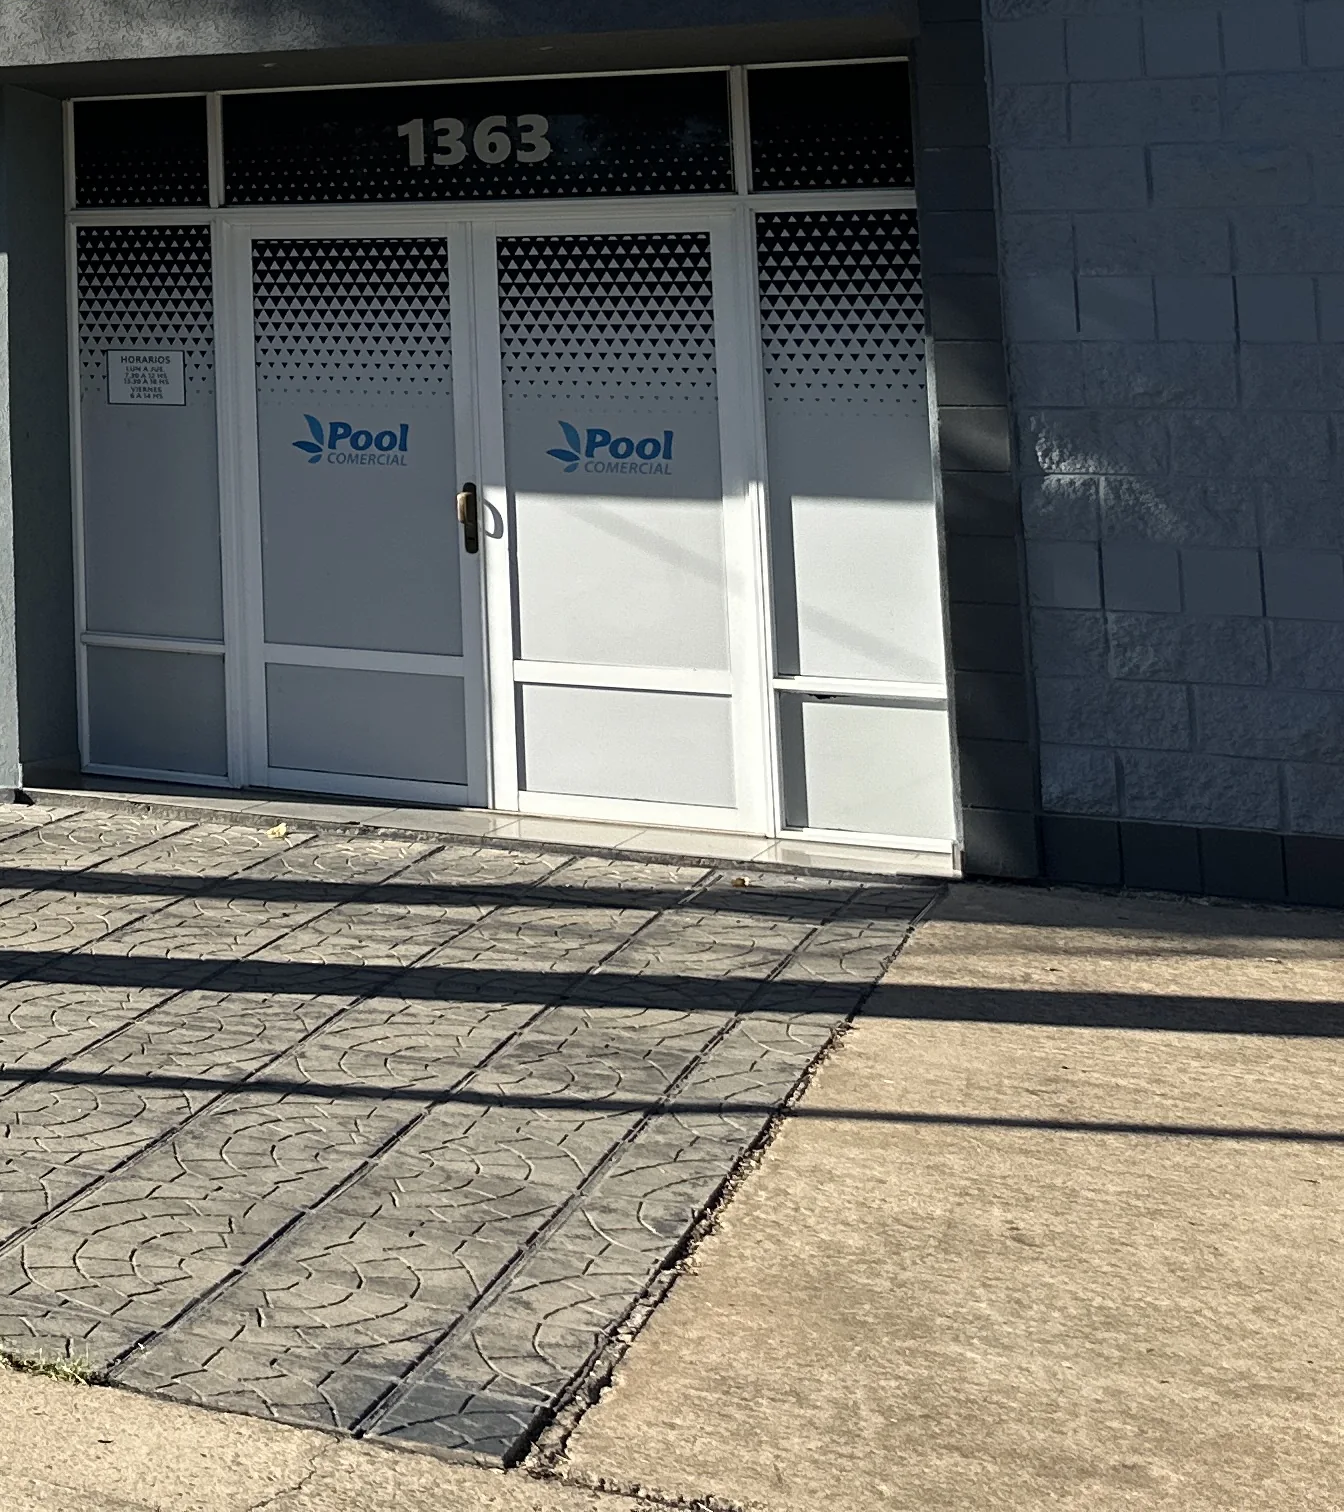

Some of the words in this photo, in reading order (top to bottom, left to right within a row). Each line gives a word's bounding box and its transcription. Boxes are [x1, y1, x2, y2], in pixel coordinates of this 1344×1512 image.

[397, 113, 551, 166] 1363
[120, 355, 171, 364] HORARIOS
[327, 421, 409, 452] Pool
[584, 428, 674, 460] Pool
[327, 452, 408, 467] COMERCIAL
[583, 461, 673, 476] COMERCIAL
